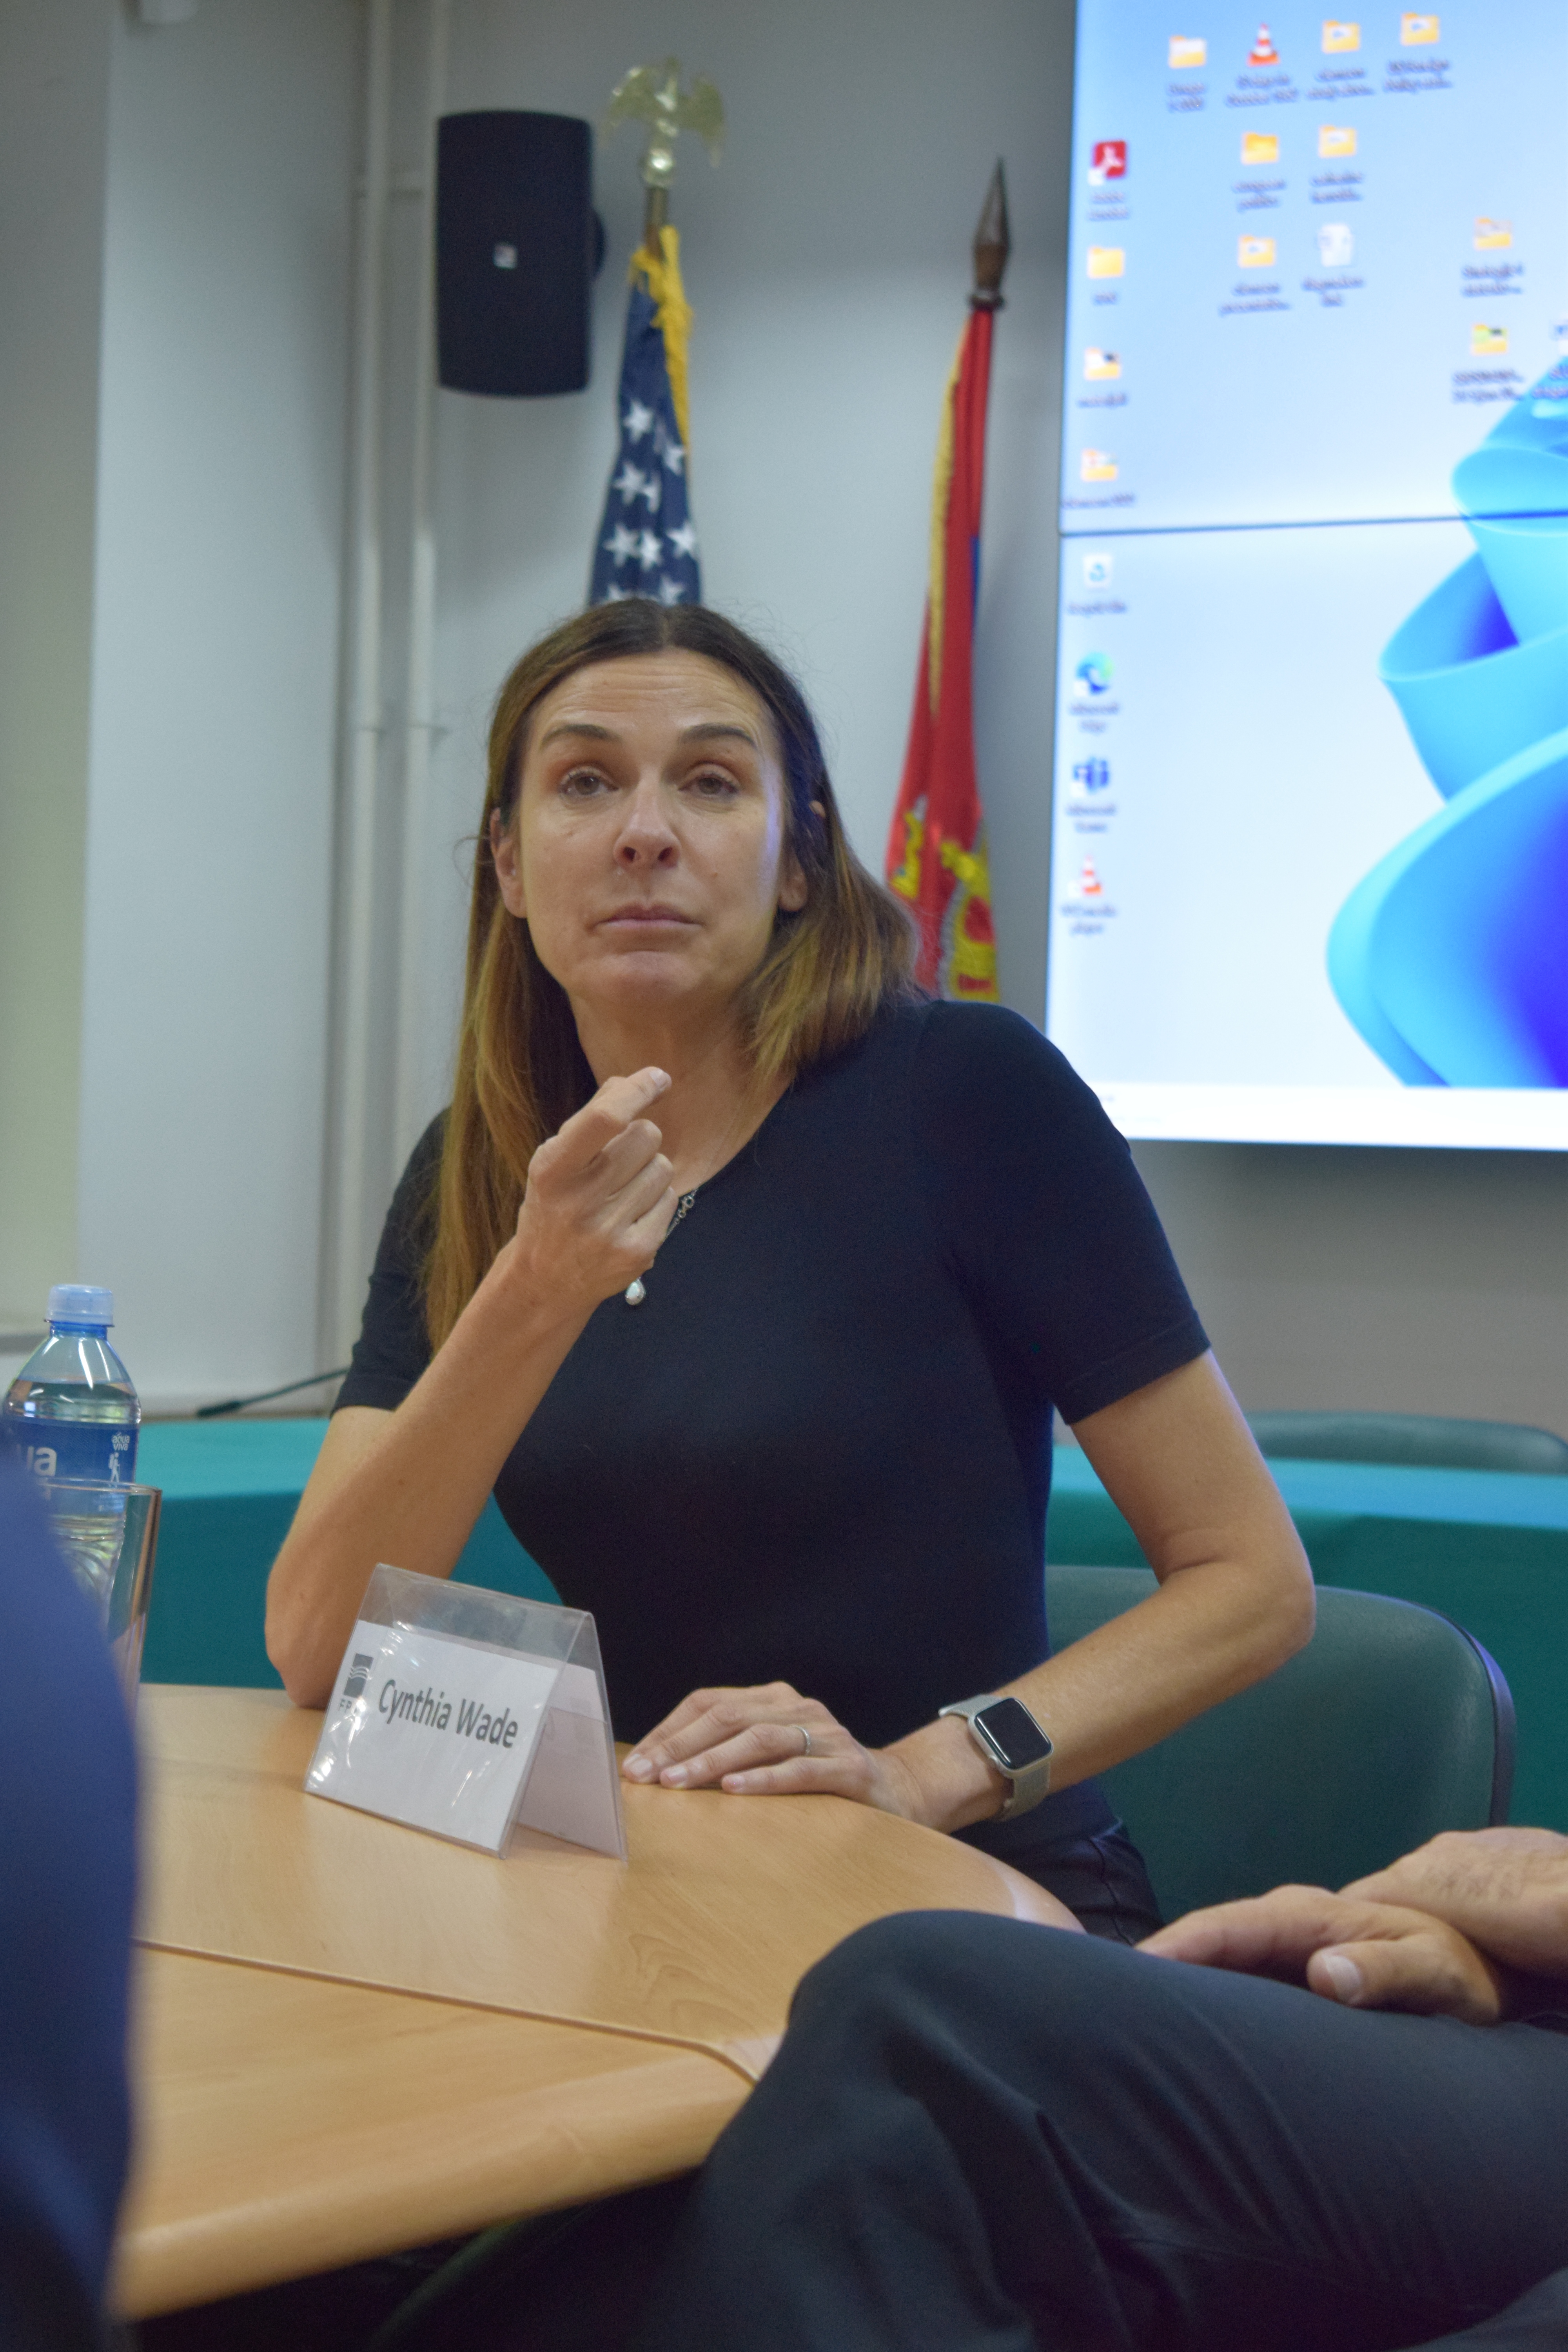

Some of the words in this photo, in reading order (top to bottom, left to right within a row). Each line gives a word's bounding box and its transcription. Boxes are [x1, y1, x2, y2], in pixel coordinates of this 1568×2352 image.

[338, 1699, 363, 1715] FP
[378, 1679, 452, 1730] Cynthia
[456, 1698, 518, 1748] Wade
